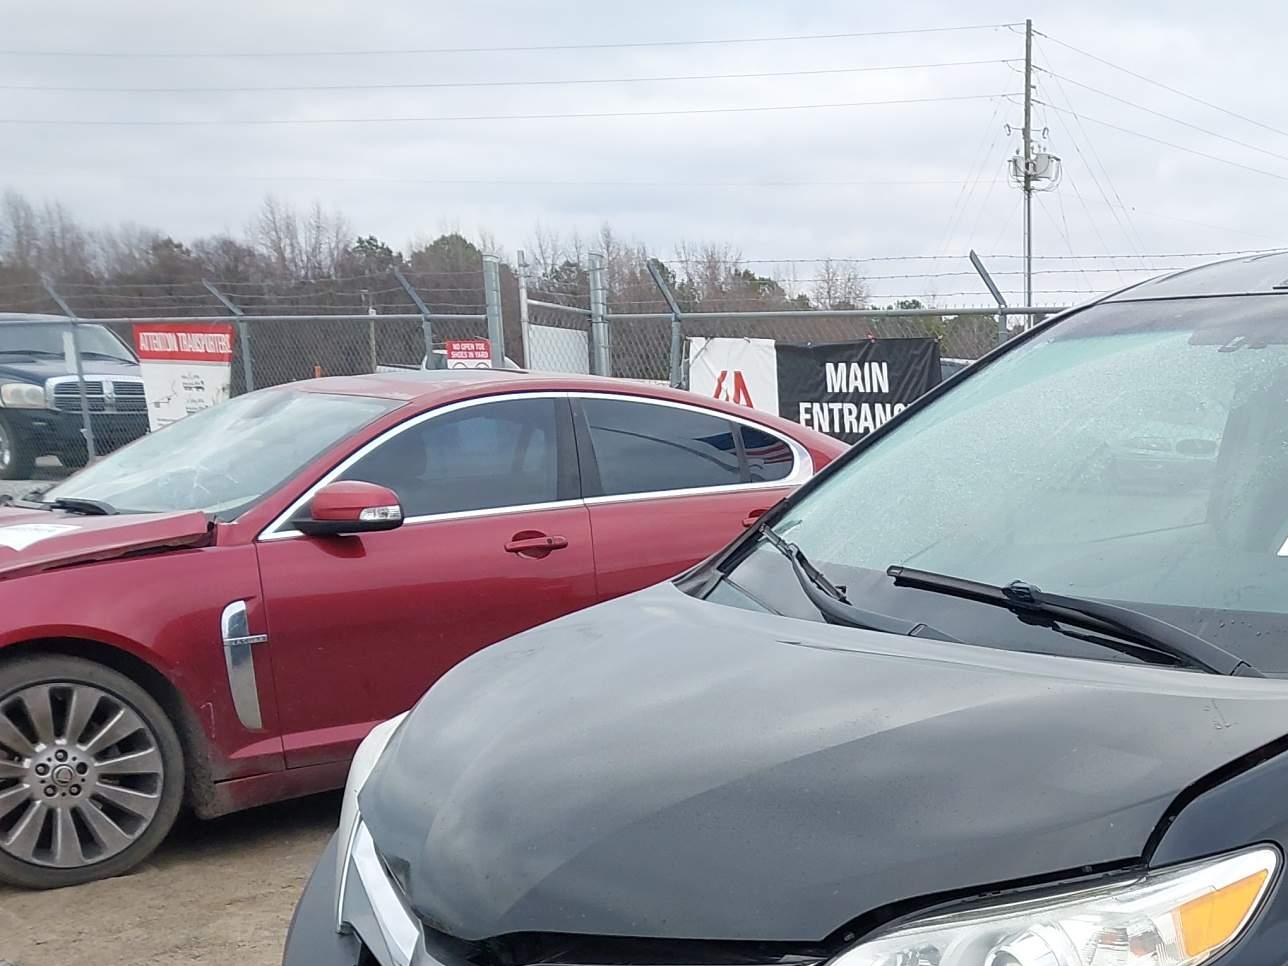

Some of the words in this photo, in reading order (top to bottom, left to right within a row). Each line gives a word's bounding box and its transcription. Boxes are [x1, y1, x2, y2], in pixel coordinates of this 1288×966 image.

[138, 331, 178, 352] ATTENTION
[452, 343, 461, 351] NO
[461, 343, 475, 351] OPEN
[475, 343, 485, 351] TOE
[450, 351, 467, 359] SHOES
[468, 351, 475, 359] IN
[475, 351, 489, 359] YARD
[825, 362, 889, 393] MAIN
